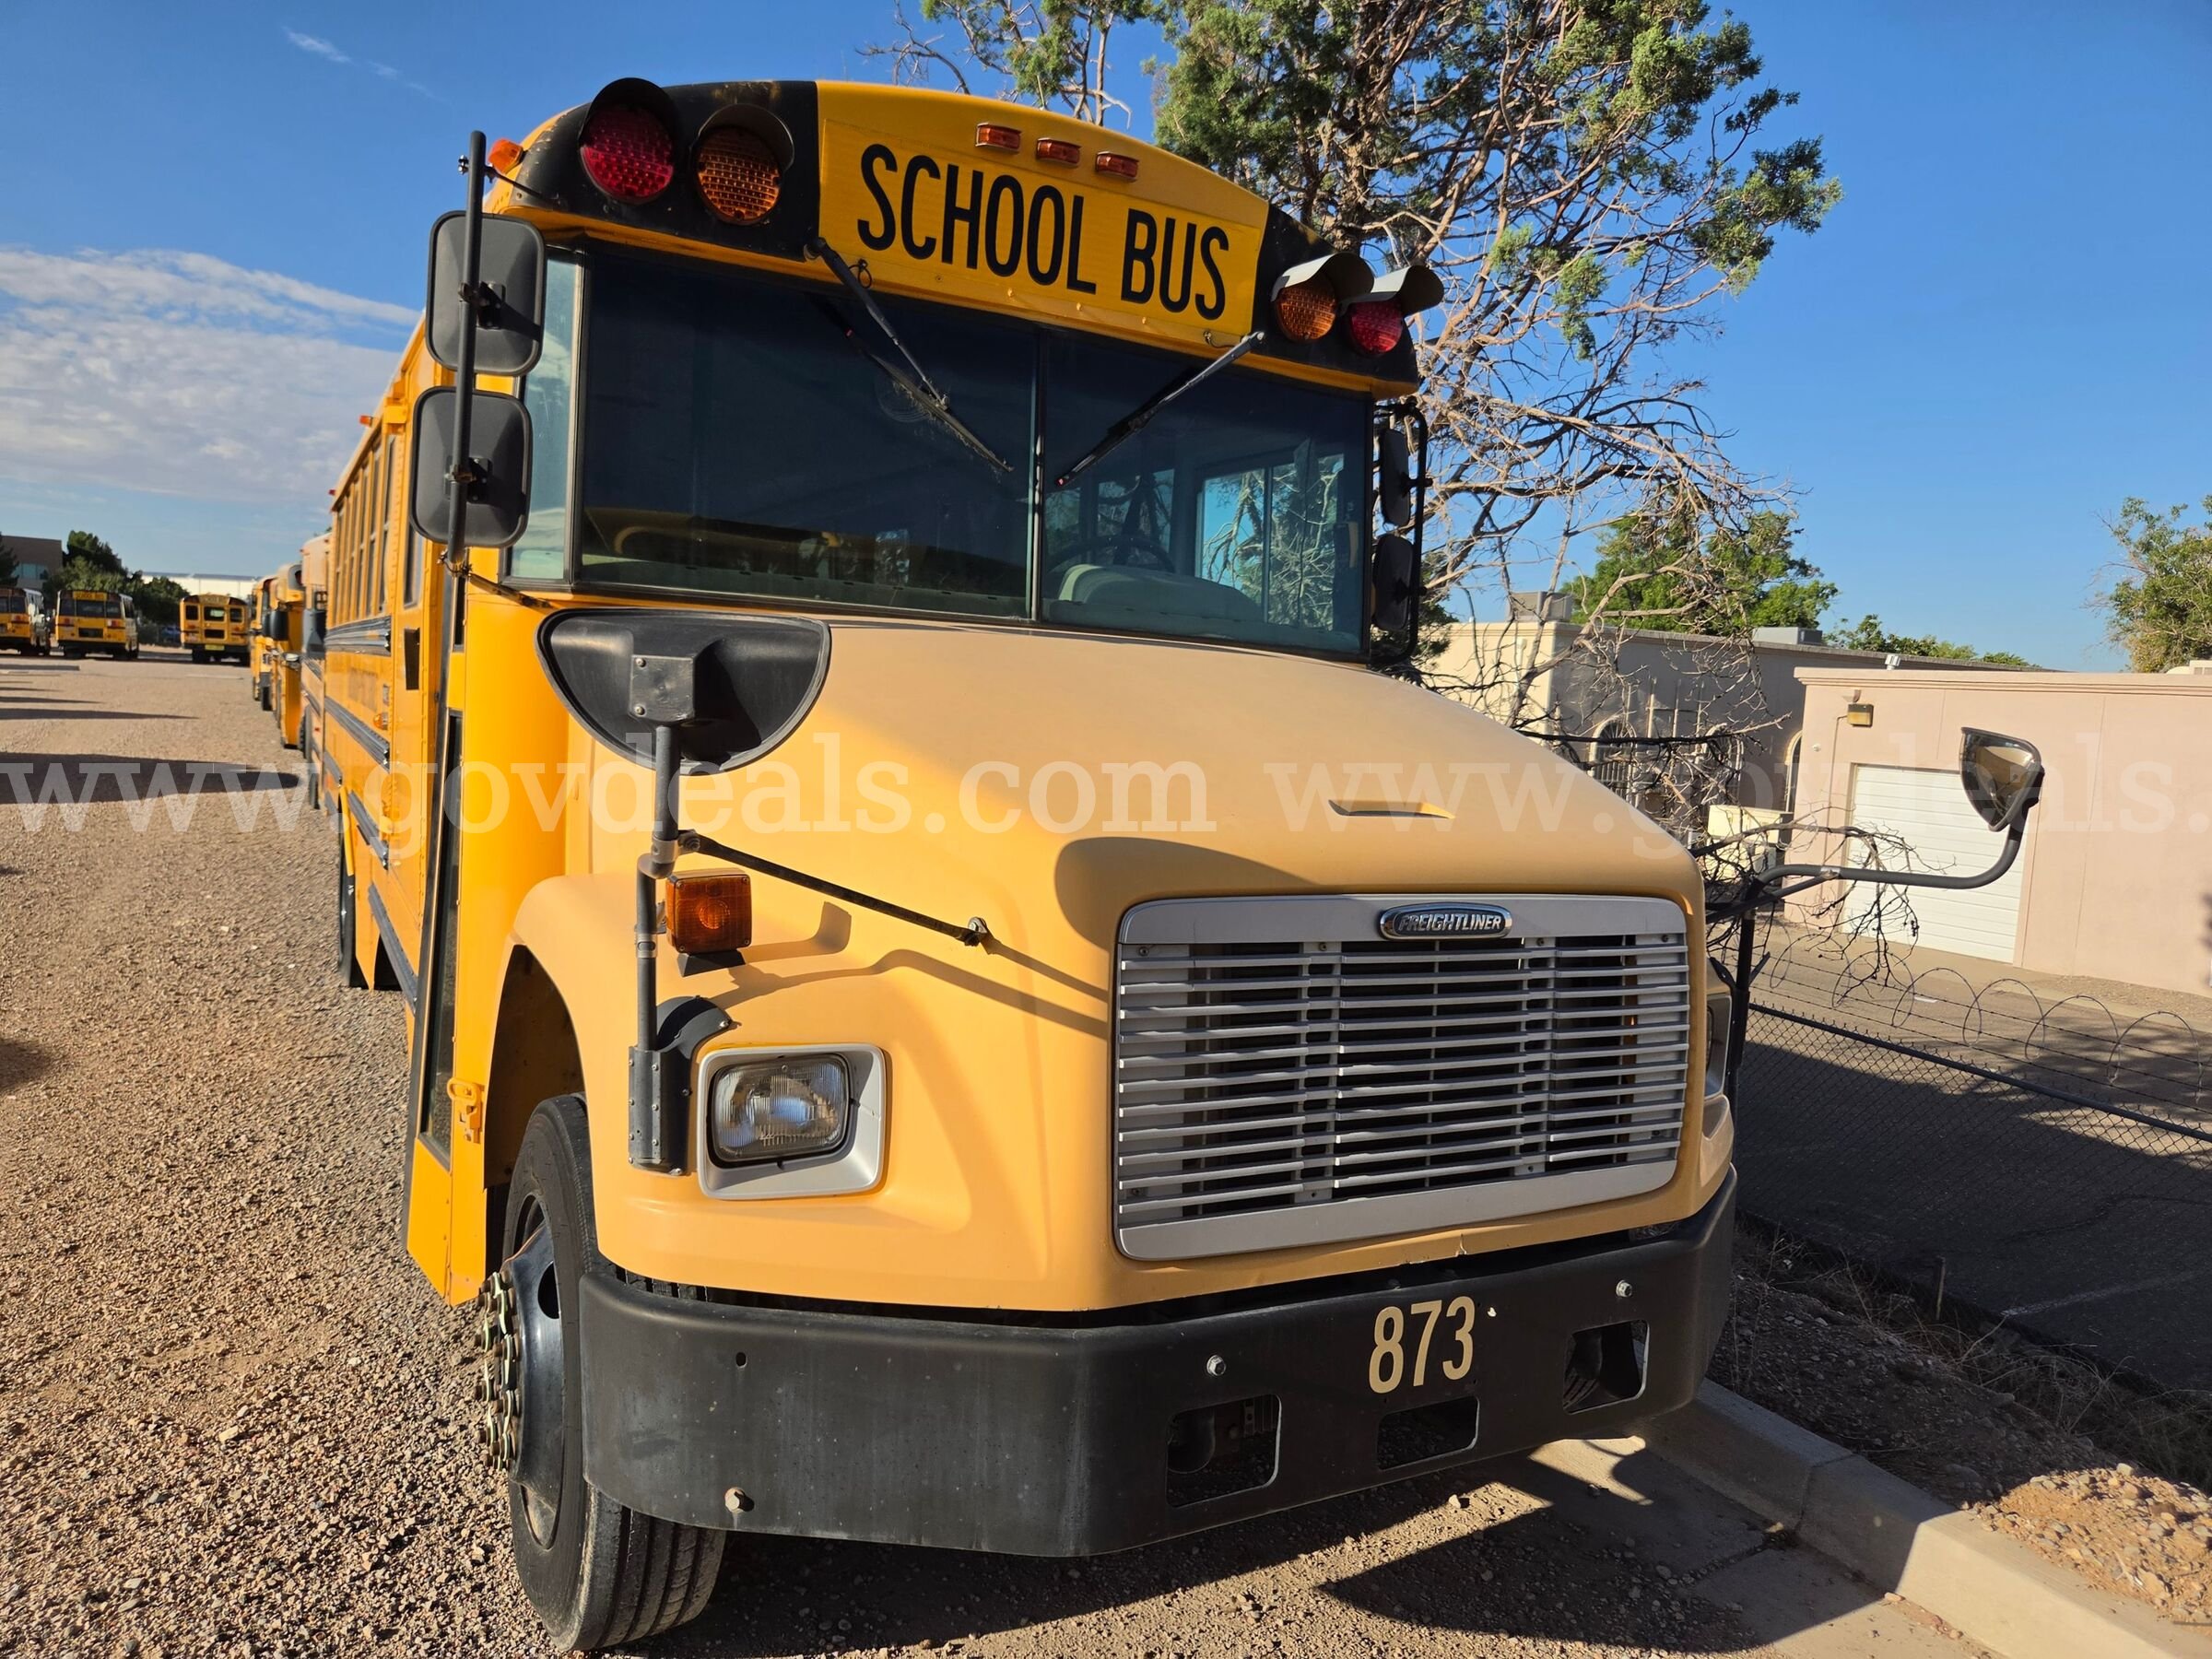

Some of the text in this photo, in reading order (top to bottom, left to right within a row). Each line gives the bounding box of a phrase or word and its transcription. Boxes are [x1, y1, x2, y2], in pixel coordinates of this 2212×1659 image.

[857, 144, 1230, 321] SCHOOL BUS
[1397, 912, 1501, 932] FREIGHTLINER
[1369, 1296, 1475, 1394] 873
